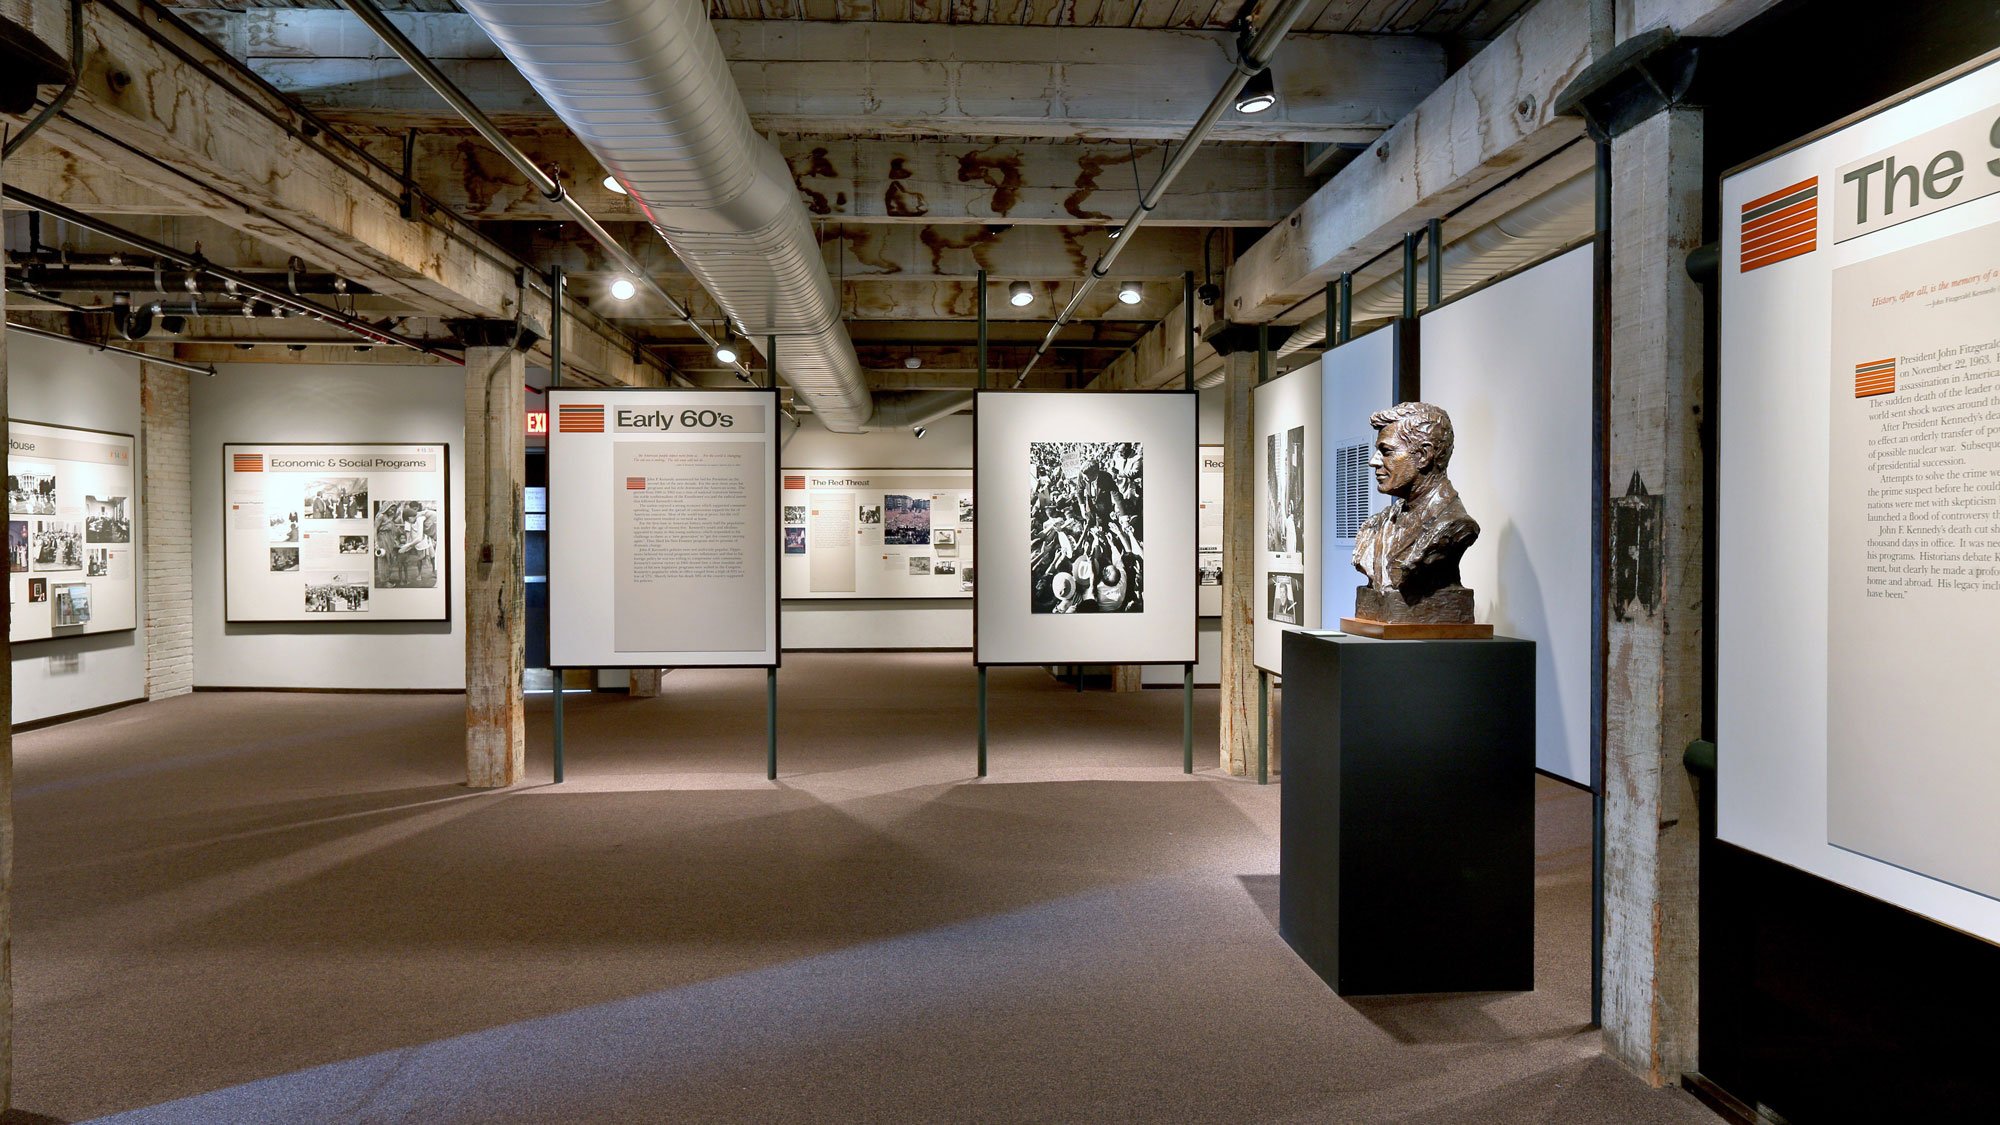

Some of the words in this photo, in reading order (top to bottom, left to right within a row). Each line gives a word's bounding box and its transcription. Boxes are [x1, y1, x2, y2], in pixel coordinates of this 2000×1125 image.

[1843, 150, 1964, 225] The
[1900, 291, 1915, 300] after
[1938, 282, 1948, 290] the
[1983, 271, 1992, 279] of
[1900, 352, 1936, 365] President
[1938, 347, 1957, 361] John
[1912, 362, 1952, 375] November
[1900, 377, 1950, 390] assassination
[1951, 375, 1960, 383] in
[1869, 398, 1884, 408] The
[1885, 395, 1912, 406] sudden
[1914, 390, 1936, 402] death
[1938, 389, 1947, 398] of
[1949, 388, 1961, 397] the
[1965, 384, 1991, 394] leader
[1869, 410, 1889, 420] world
[1890, 409, 1906, 418] sent
[1908, 405, 1930, 416] shock
[1932, 404, 1955, 412] waves
[1957, 398, 1988, 409] around
[528, 413, 546, 432] EXI
[617, 409, 674, 430] Early
[680, 409, 734, 428] 60's
[1881, 423, 1900, 432] After
[1902, 419, 1938, 430] President
[1940, 413, 1983, 425] Kennedy's
[1878, 436, 1897, 445] effect
[1910, 431, 1938, 442] orderly
[1941, 428, 1973, 439] transfer
[1975, 426, 1985, 435] of
[1868, 449, 1876, 458] of
[1878, 447, 1906, 460] possible
[1908, 445, 1938, 455] nuclear
[271, 459, 326, 468] Economic
[328, 459, 336, 468] &
[338, 459, 373, 468] Social
[375, 459, 426, 470] Programs
[1868, 462, 1876, 471] of
[1877, 459, 1921, 473] presidential
[1922, 457, 1966, 467] succession.
[1880, 474, 1914, 484] Attempts
[1925, 471, 1944, 480] solve
[1946, 470, 1960, 479] the
[1962, 469, 1988, 478] crime
[1867, 488, 1879, 496] the
[1881, 487, 1902, 499] prime
[1904, 486, 1933, 497] suspect
[1935, 484, 1960, 493] before
[1963, 483, 1974, 492] he
[1867, 500, 1894, 509] nations
[1932, 497, 1950, 506] with
[1951, 497, 1996, 508] skepticism
[1867, 512, 1901, 521] launched
[1909, 512, 1929, 521] flood
[1931, 511, 1940, 520] of
[1941, 512, 1990, 522] controversy
[1878, 525, 1896, 537] John
[1906, 525, 1946, 536] Kennedy's
[1948, 525, 1972, 534] death
[1867, 538, 1900, 547] thousand
[1902, 538, 1919, 550] days
[1921, 539, 1928, 547] in
[1930, 538, 1955, 547] office.
[1960, 539, 1966, 547] It
[1867, 550, 1878, 559] his
[1879, 553, 1915, 562] programs.
[1920, 552, 1961, 561] Historians
[1962, 552, 1992, 561] debate
[1867, 565, 1887, 574] ment,
[1888, 564, 1901, 573] but
[1902, 564, 1928, 576] clearly
[1930, 565, 1940, 574] he
[1943, 566, 1966, 575] made
[1867, 576, 1886, 585] home
[1888, 577, 1902, 586] and
[1904, 578, 1933, 587] abroad.
[1938, 579, 1952, 588] His
[1954, 580, 1980, 592] legacy
[1867, 588, 1883, 598] have
